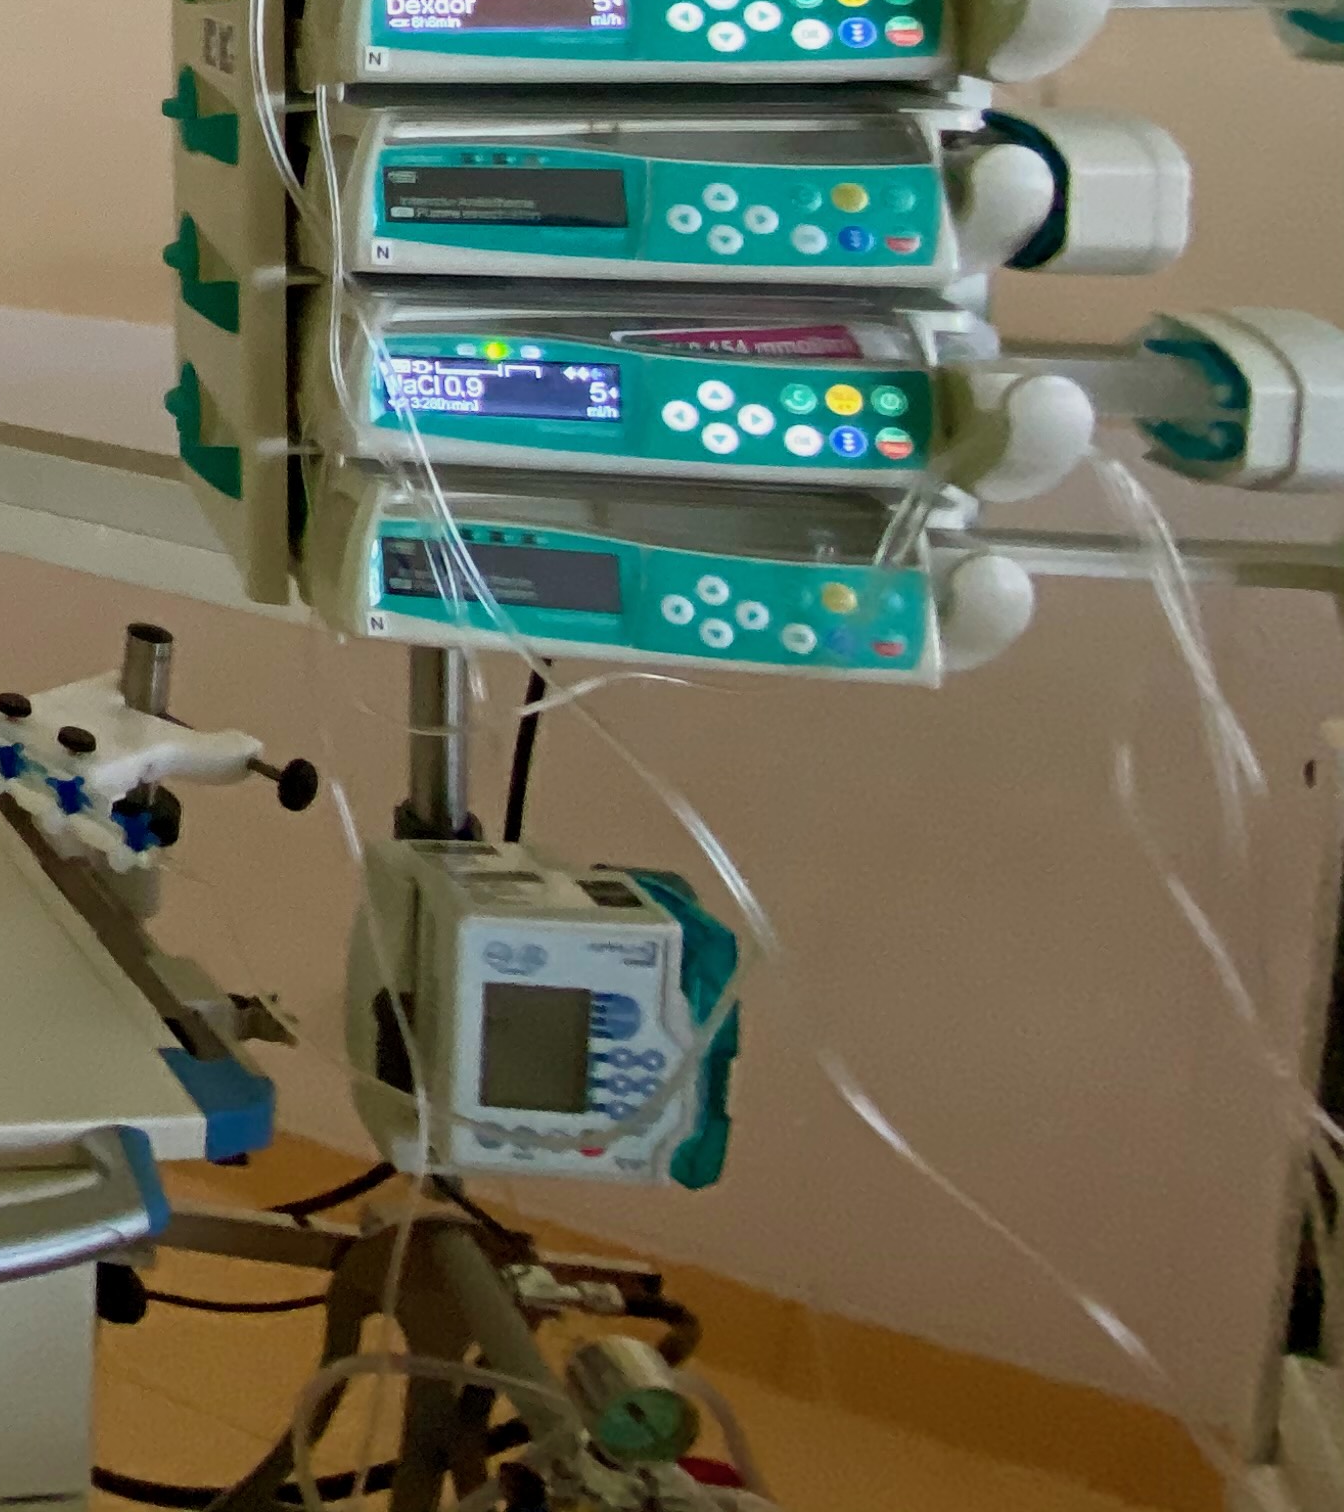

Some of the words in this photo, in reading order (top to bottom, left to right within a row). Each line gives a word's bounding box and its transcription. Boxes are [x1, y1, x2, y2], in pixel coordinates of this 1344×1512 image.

[368, 52, 382, 65] N
[376, 246, 390, 260] N
[589, 382, 607, 403] 5
[370, 617, 385, 631] N
